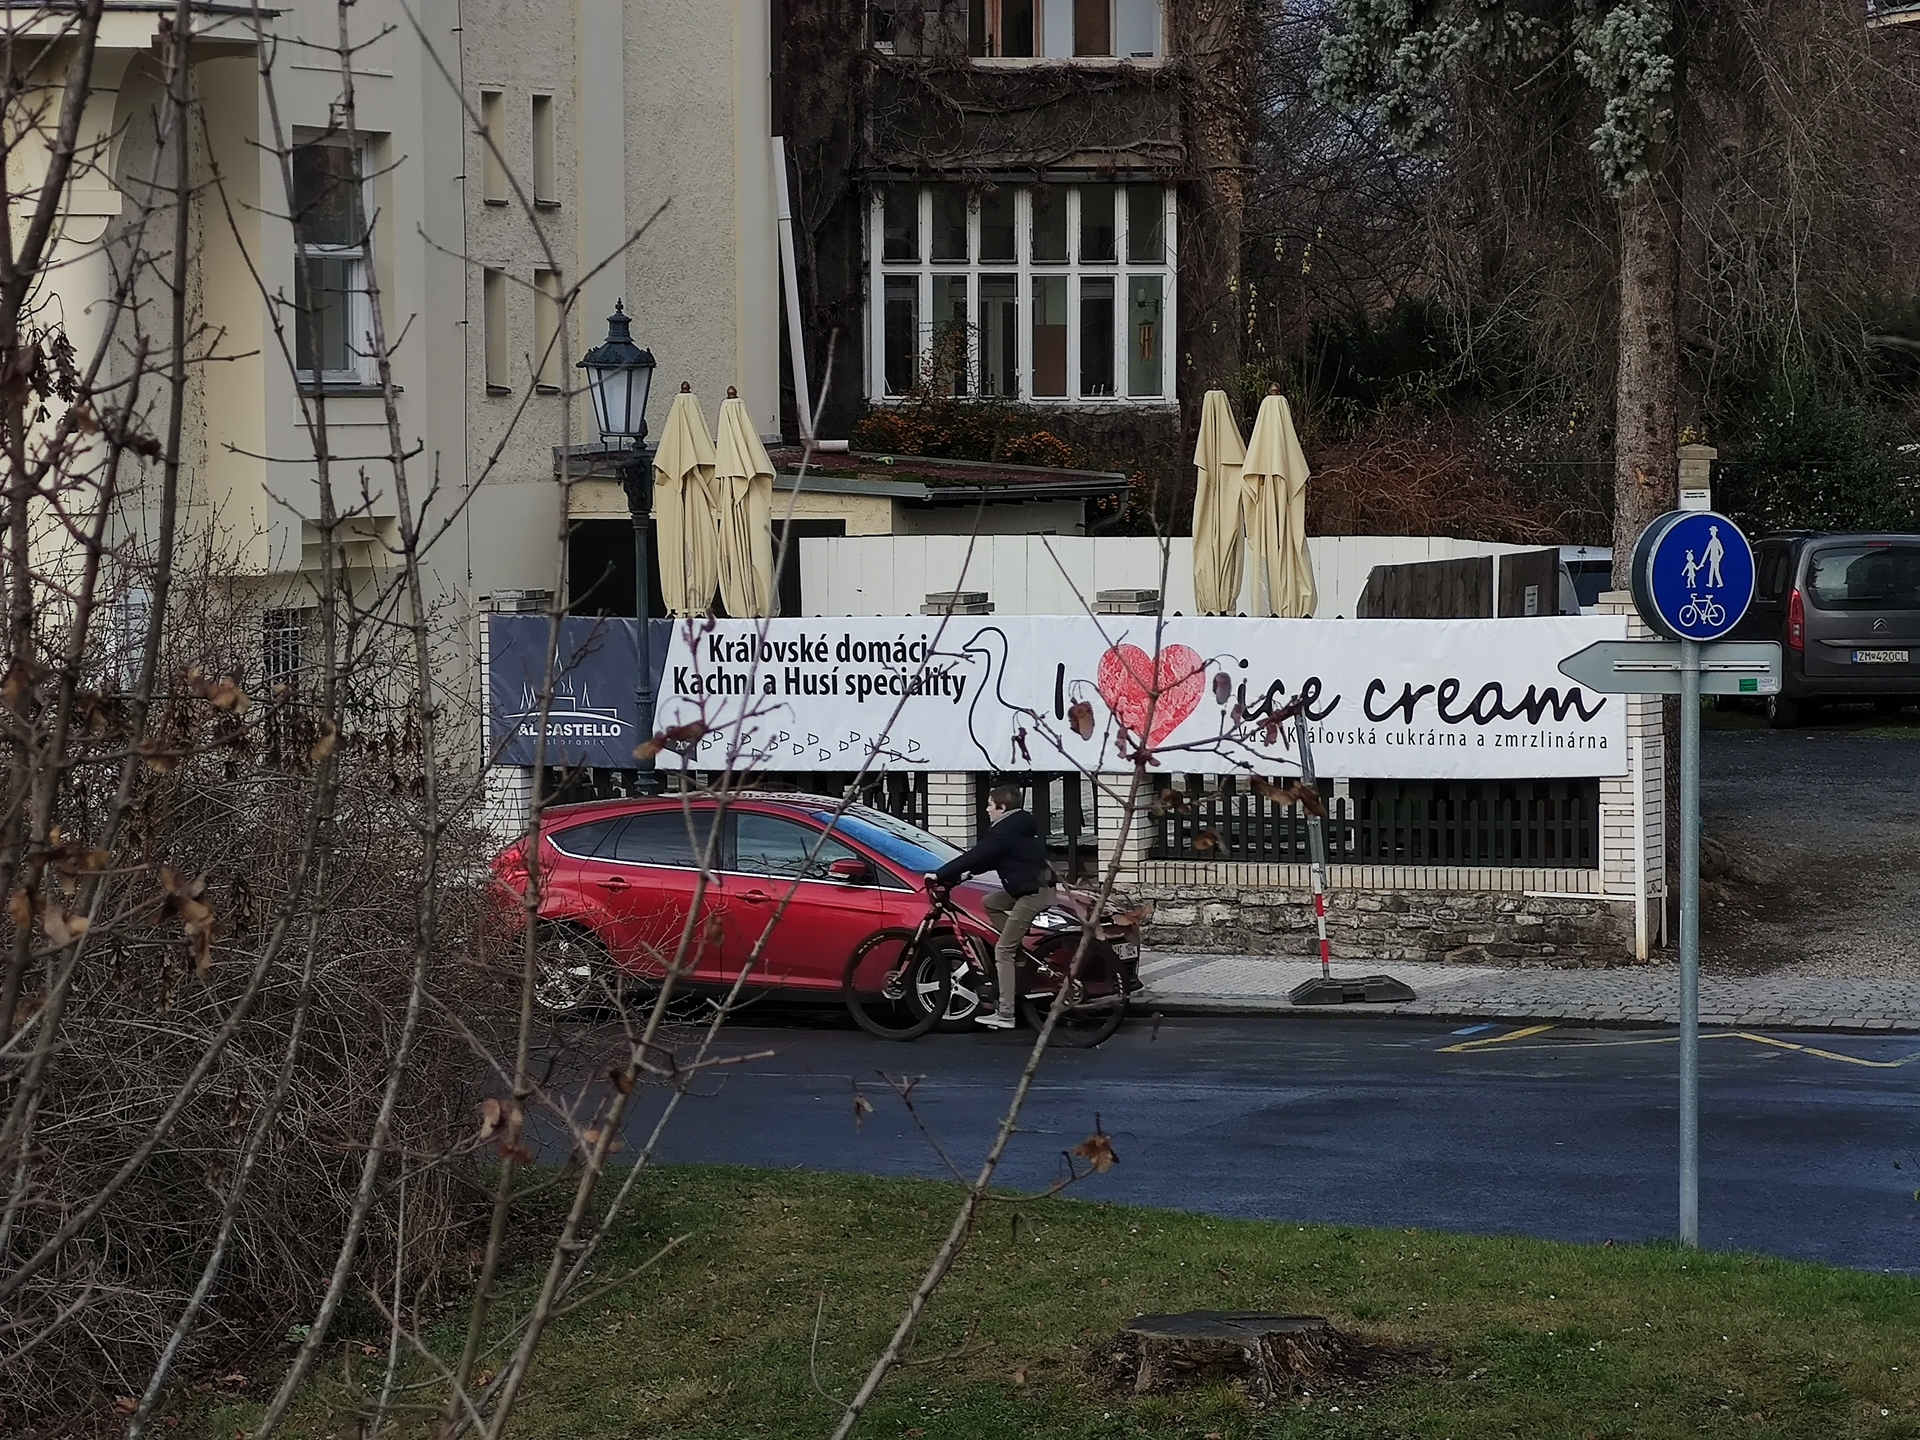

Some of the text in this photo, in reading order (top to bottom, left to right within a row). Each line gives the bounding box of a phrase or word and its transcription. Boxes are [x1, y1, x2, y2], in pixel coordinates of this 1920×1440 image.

[709, 633, 927, 662] Královské domáci
[763, 673, 776, 694] a
[785, 666, 838, 695] Husí
[845, 667, 966, 704] speciality
[1237, 658, 1341, 721] ice
[1363, 678, 1608, 726] cream
[518, 723, 538, 736] AL
[1287, 727, 1377, 744] Kálovská
[1385, 728, 1467, 747] cukrárna
[1476, 733, 1485, 747] a
[1494, 731, 1608, 750] zmrzlinárna
